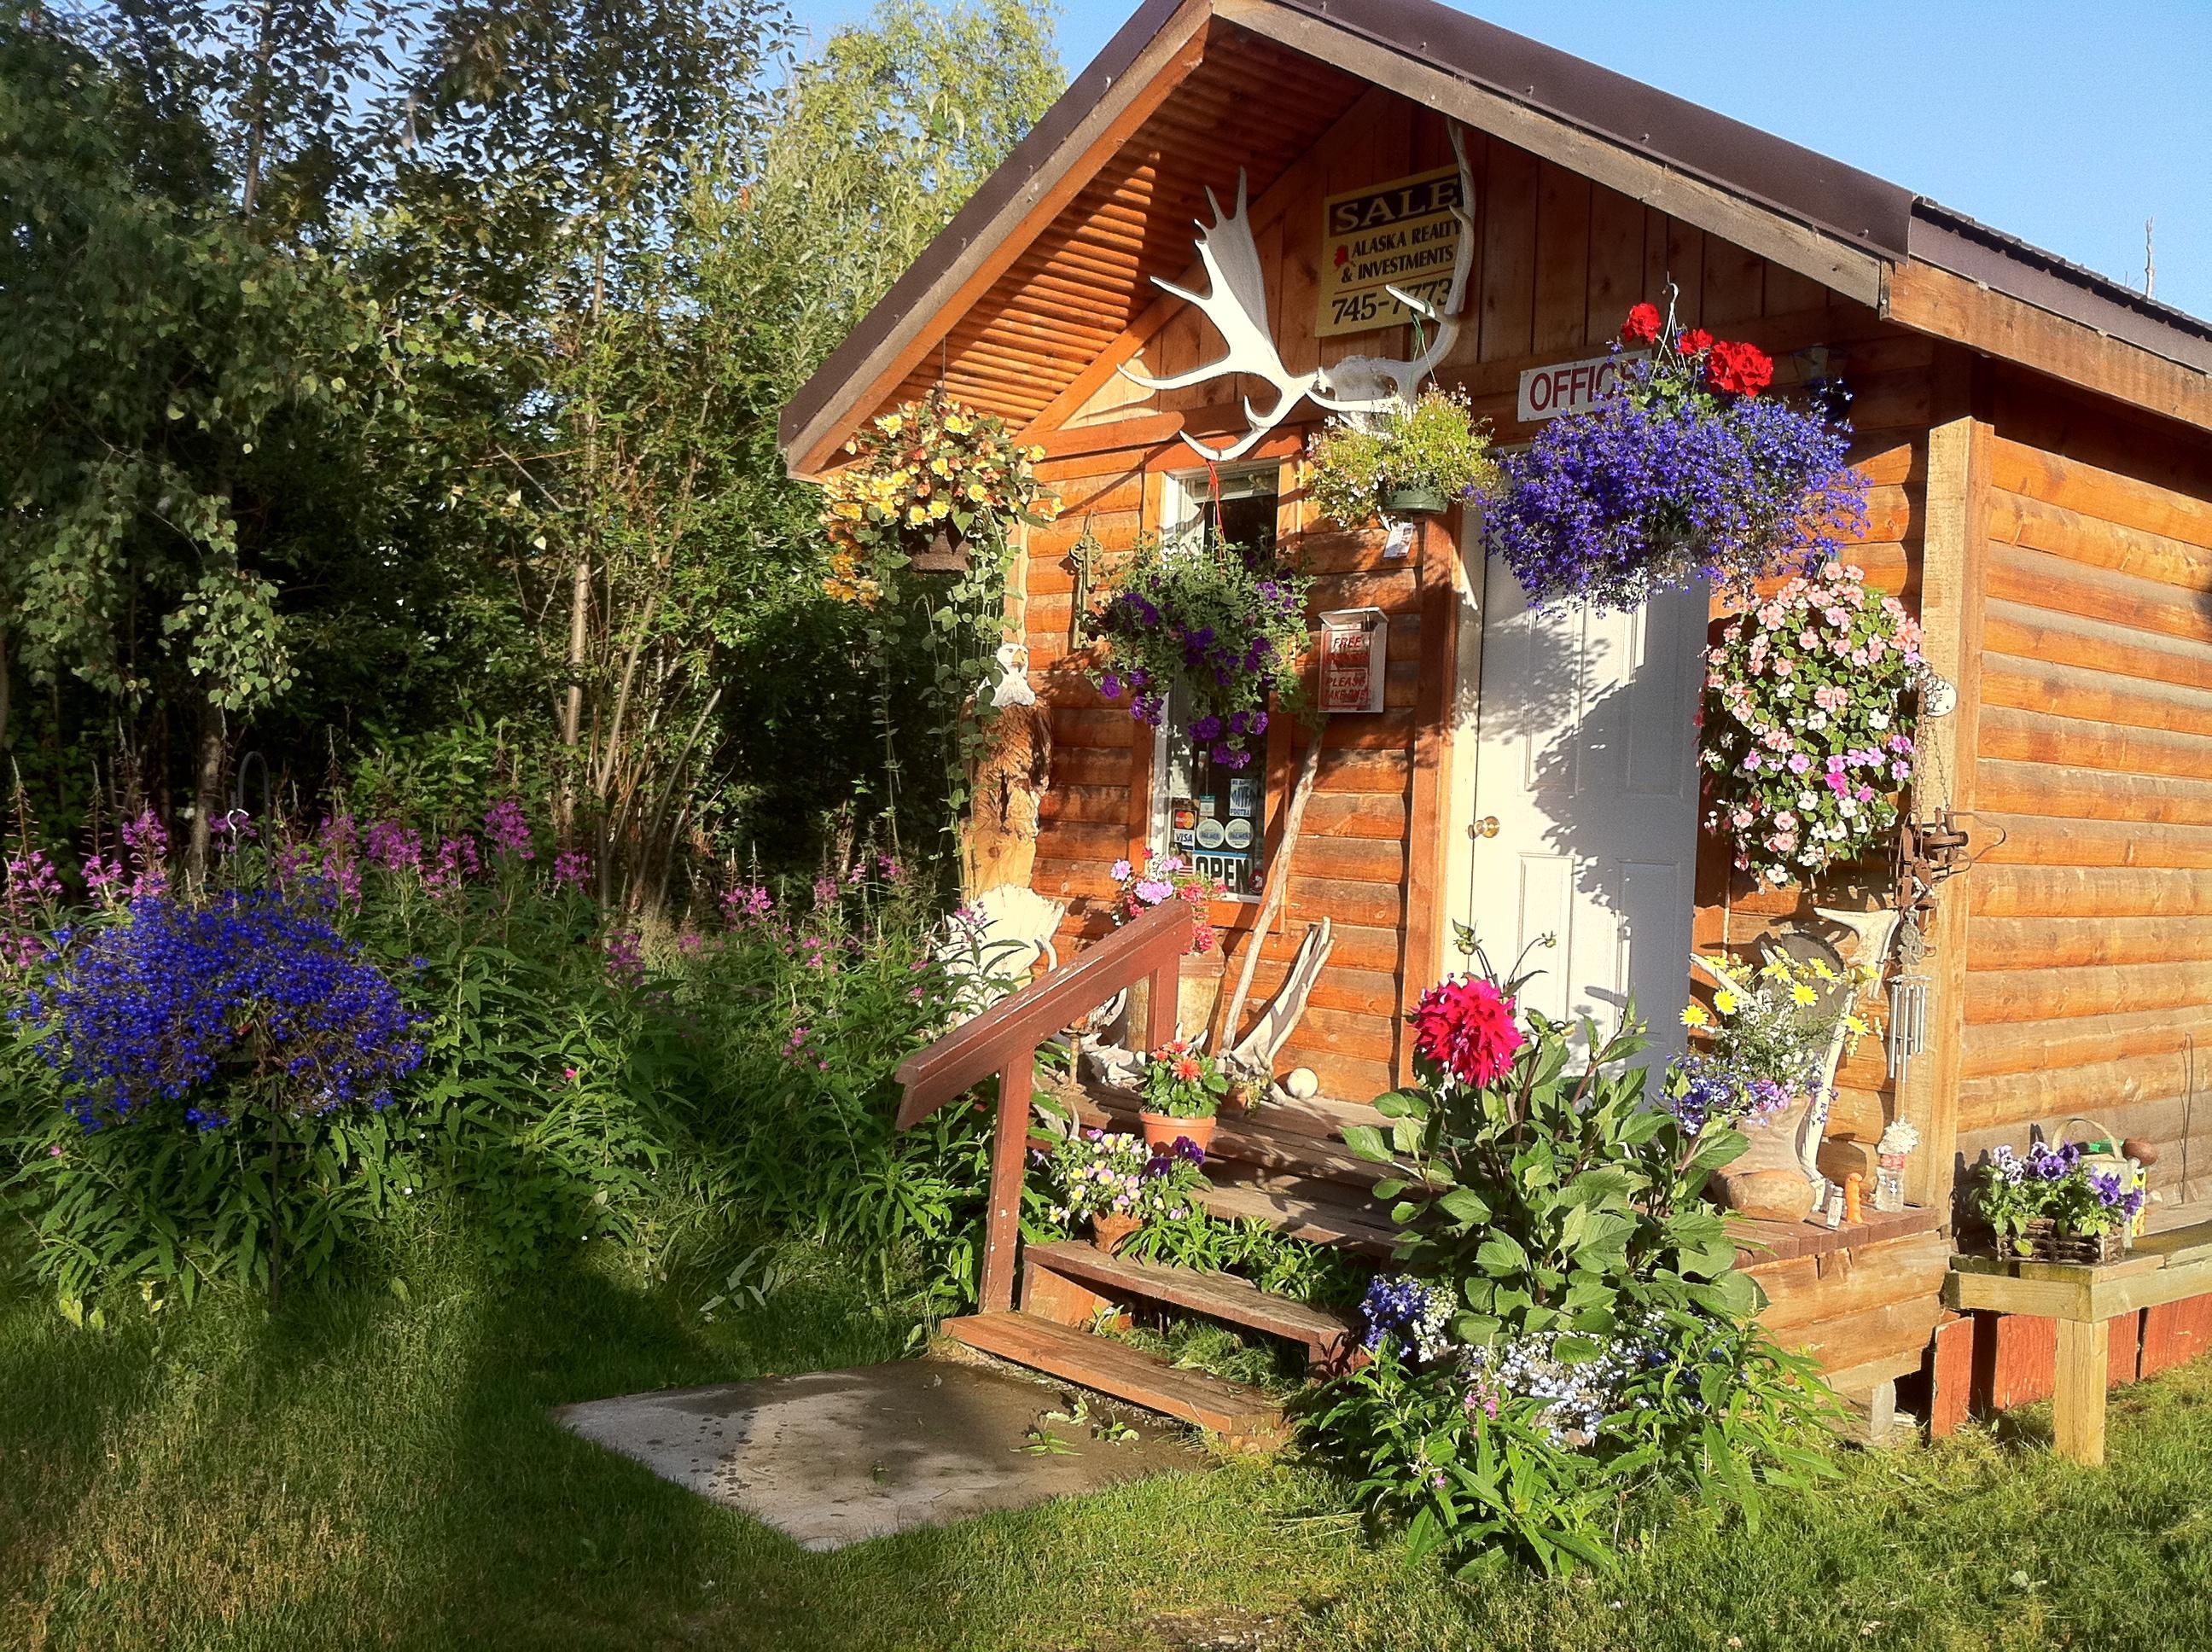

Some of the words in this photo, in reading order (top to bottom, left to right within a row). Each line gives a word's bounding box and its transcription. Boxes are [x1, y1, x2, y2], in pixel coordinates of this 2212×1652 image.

[1336, 177, 1458, 232] SALE
[1352, 232, 1406, 257] ALASKA
[1412, 218, 1462, 245] REALTY
[1341, 266, 1353, 283] &
[1358, 245, 1453, 280] INVESTMENTS
[1333, 636, 1362, 649] FREE
[1176, 833, 1193, 842] VISA
[1196, 857, 1249, 893] OPEN
